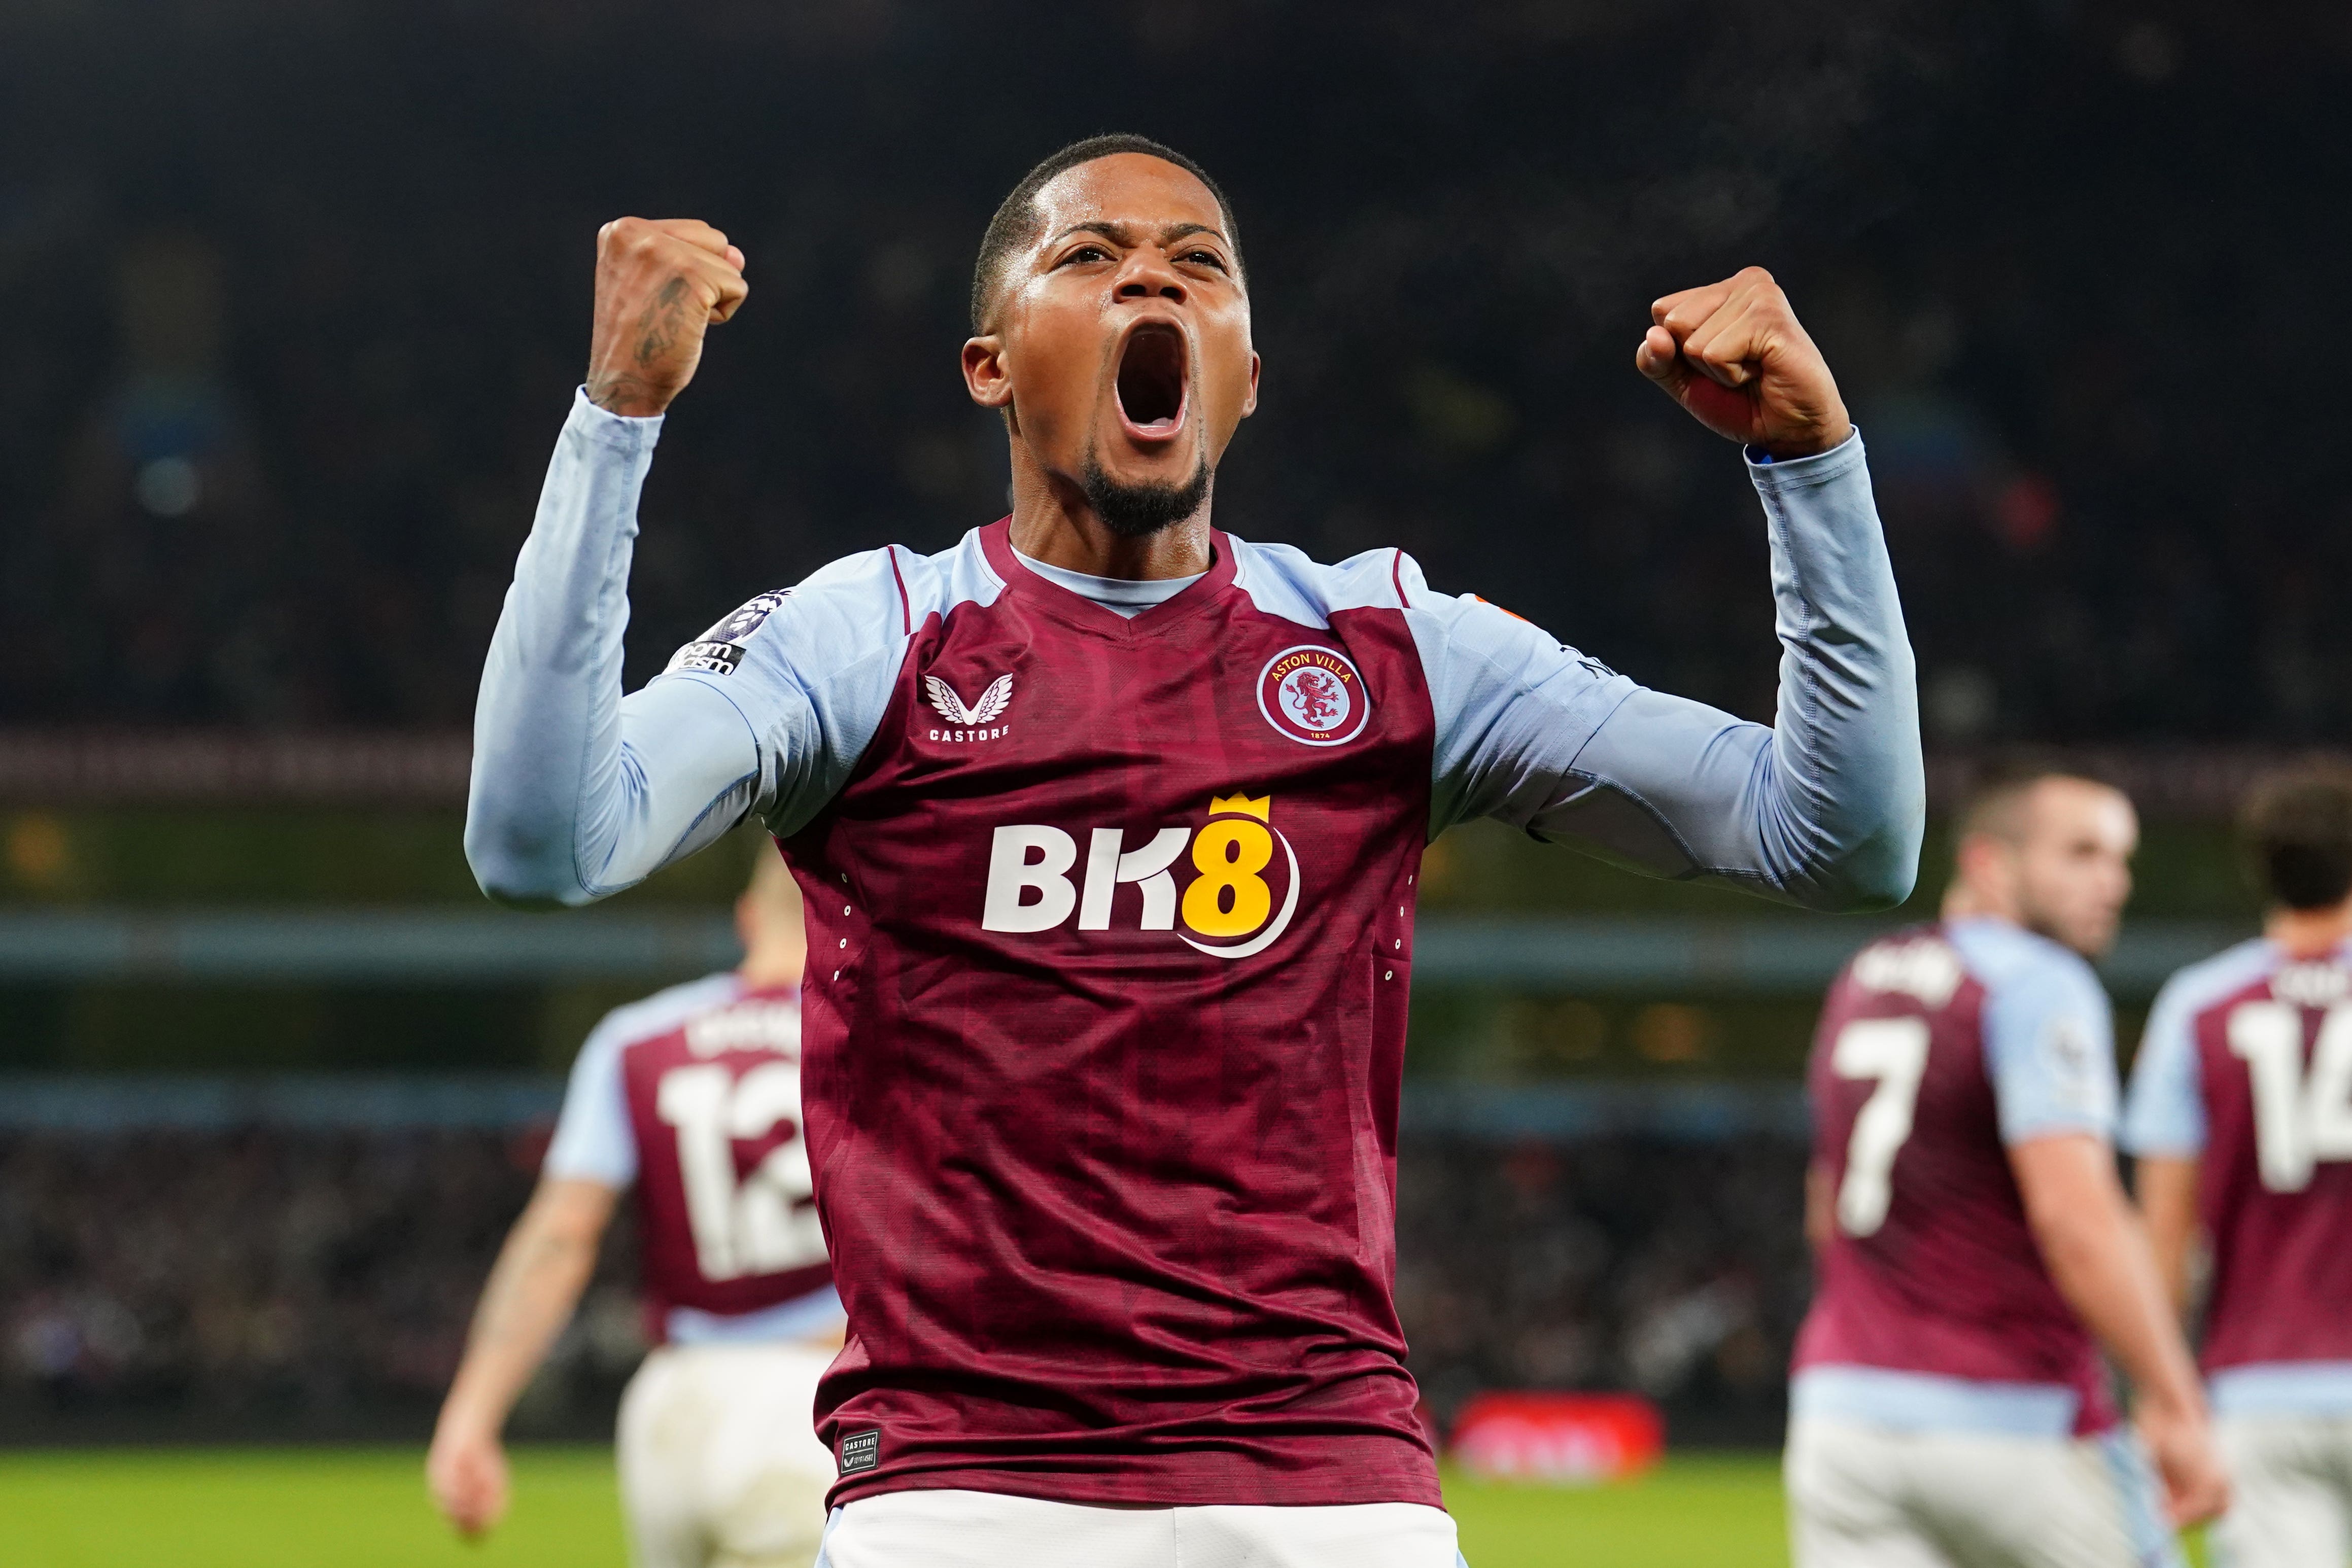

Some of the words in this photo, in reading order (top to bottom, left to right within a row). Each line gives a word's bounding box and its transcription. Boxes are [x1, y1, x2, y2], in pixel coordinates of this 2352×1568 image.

[1272, 653, 1310, 681] ASTON
[1316, 654, 1352, 683] VILLA
[929, 725, 1009, 742] CASTORE
[981, 818, 1273, 937] BK8
[1831, 1017, 1930, 1239] 7
[845, 1437, 875, 1451] CASTORE
